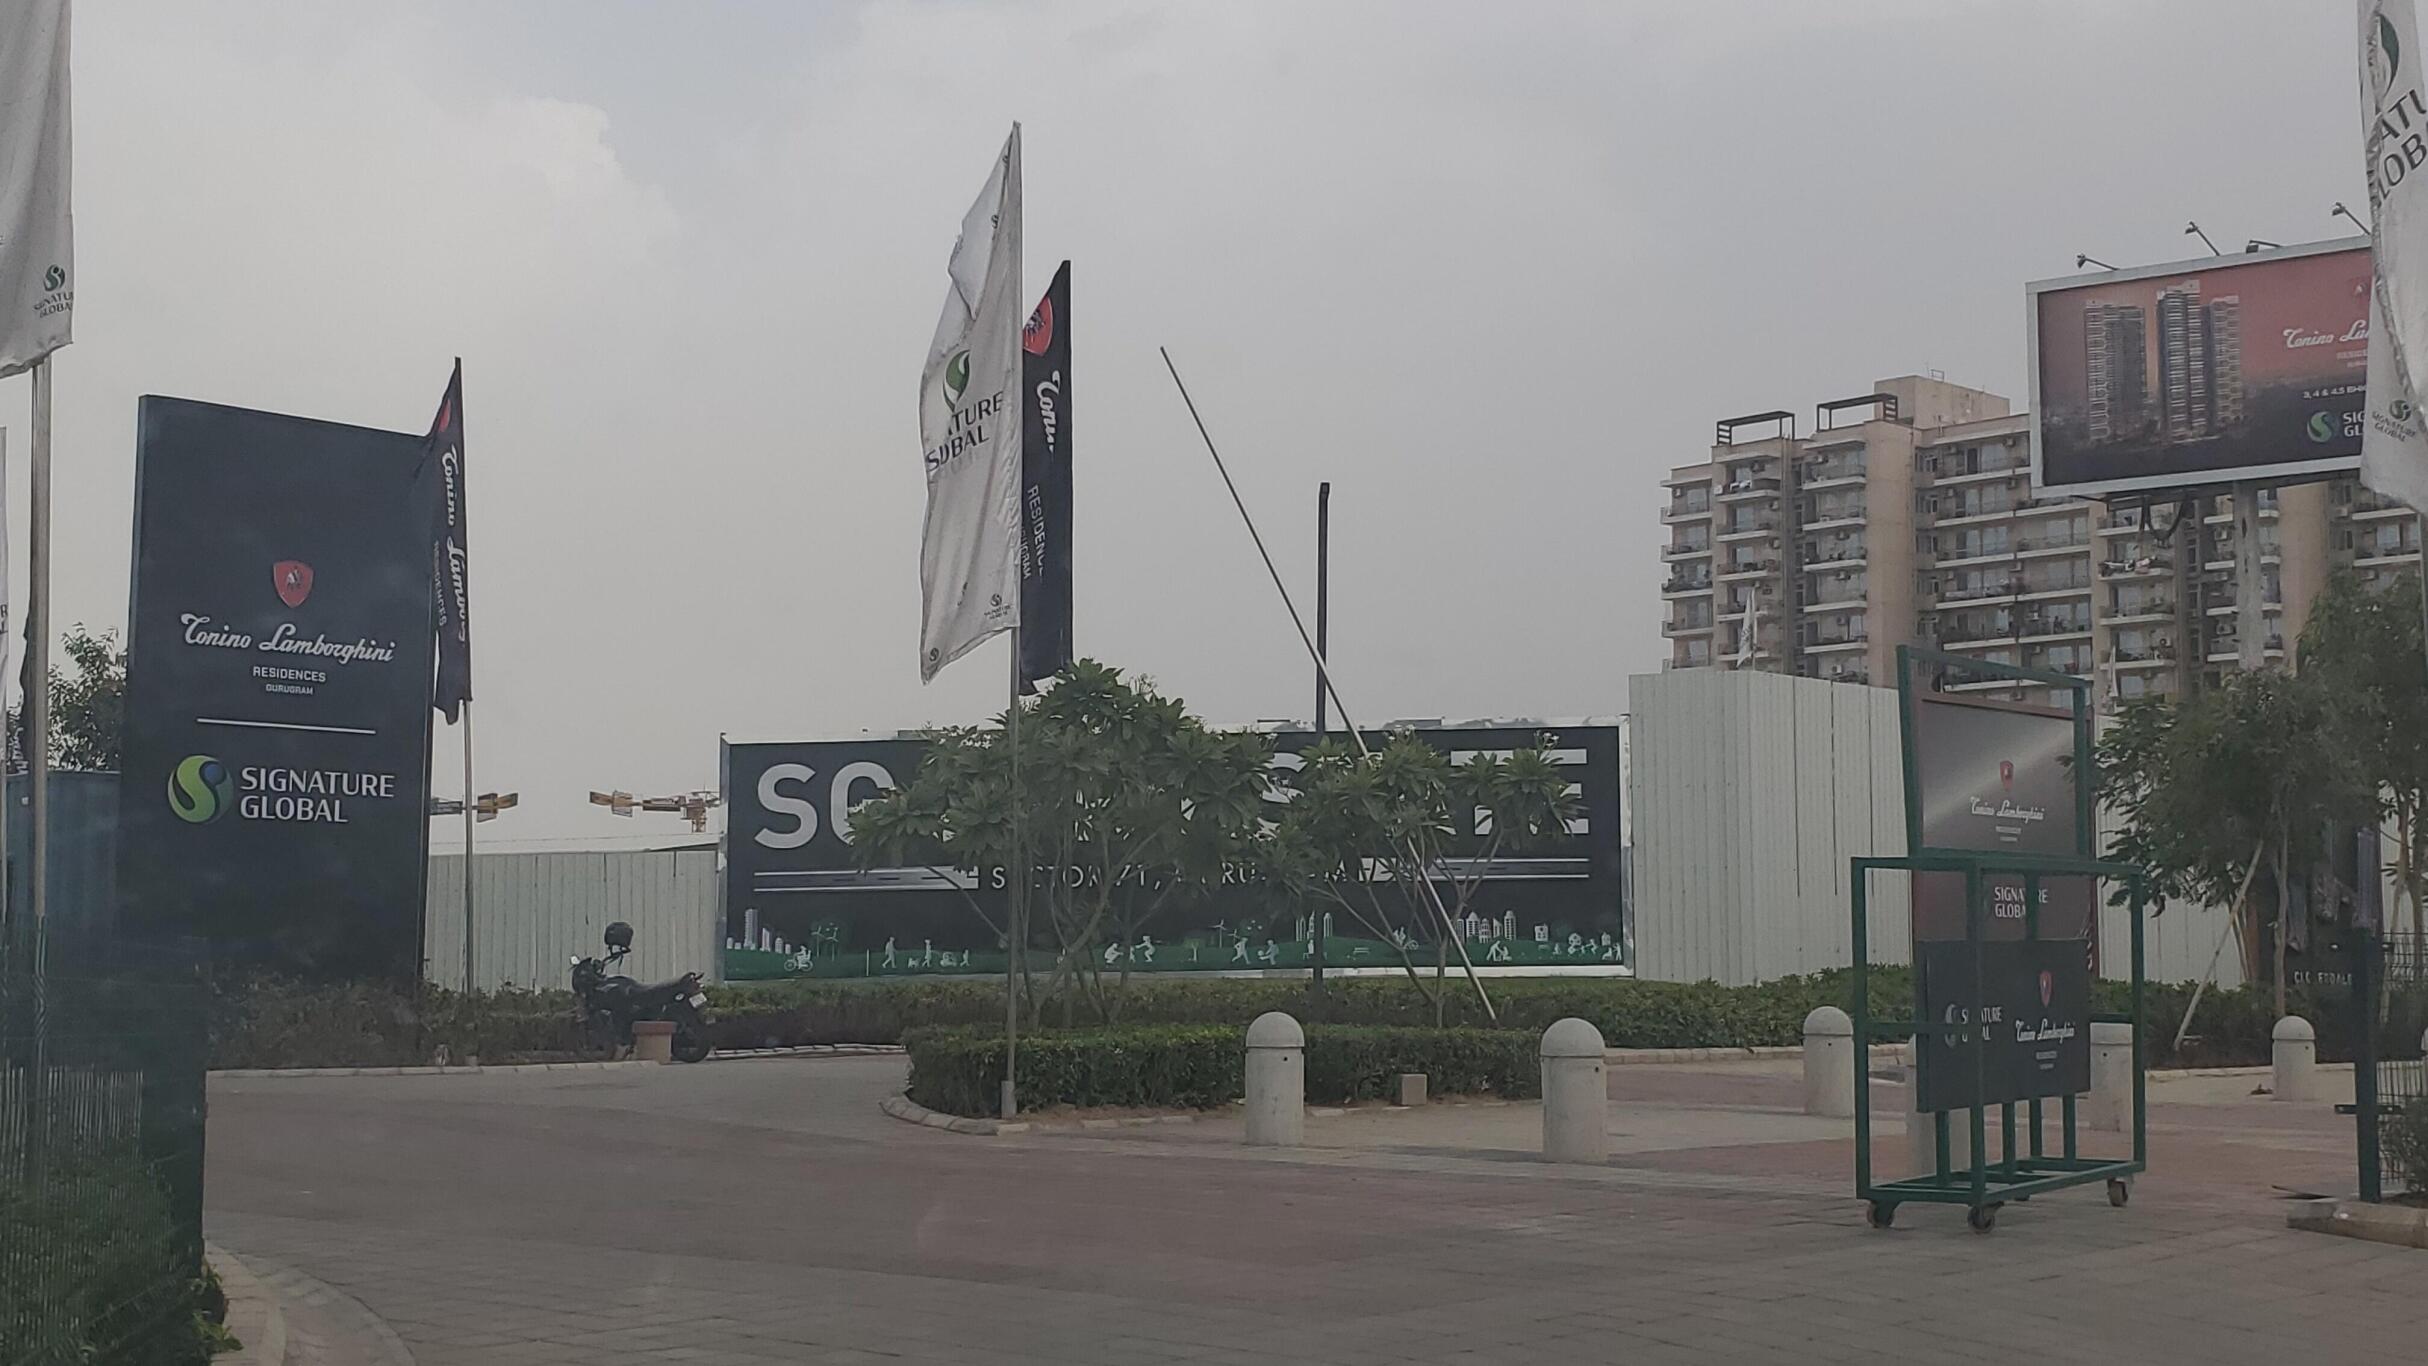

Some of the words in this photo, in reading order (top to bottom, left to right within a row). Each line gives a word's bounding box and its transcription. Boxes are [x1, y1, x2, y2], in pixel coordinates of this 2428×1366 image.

[180, 613, 252, 649] Tonino
[258, 623, 396, 664] Lamborghini
[252, 666, 326, 682] RESIDENCES
[265, 684, 314, 695] GURUGRAM
[240, 766, 395, 798] SIGNATURE
[240, 795, 348, 823] GLOBAL
